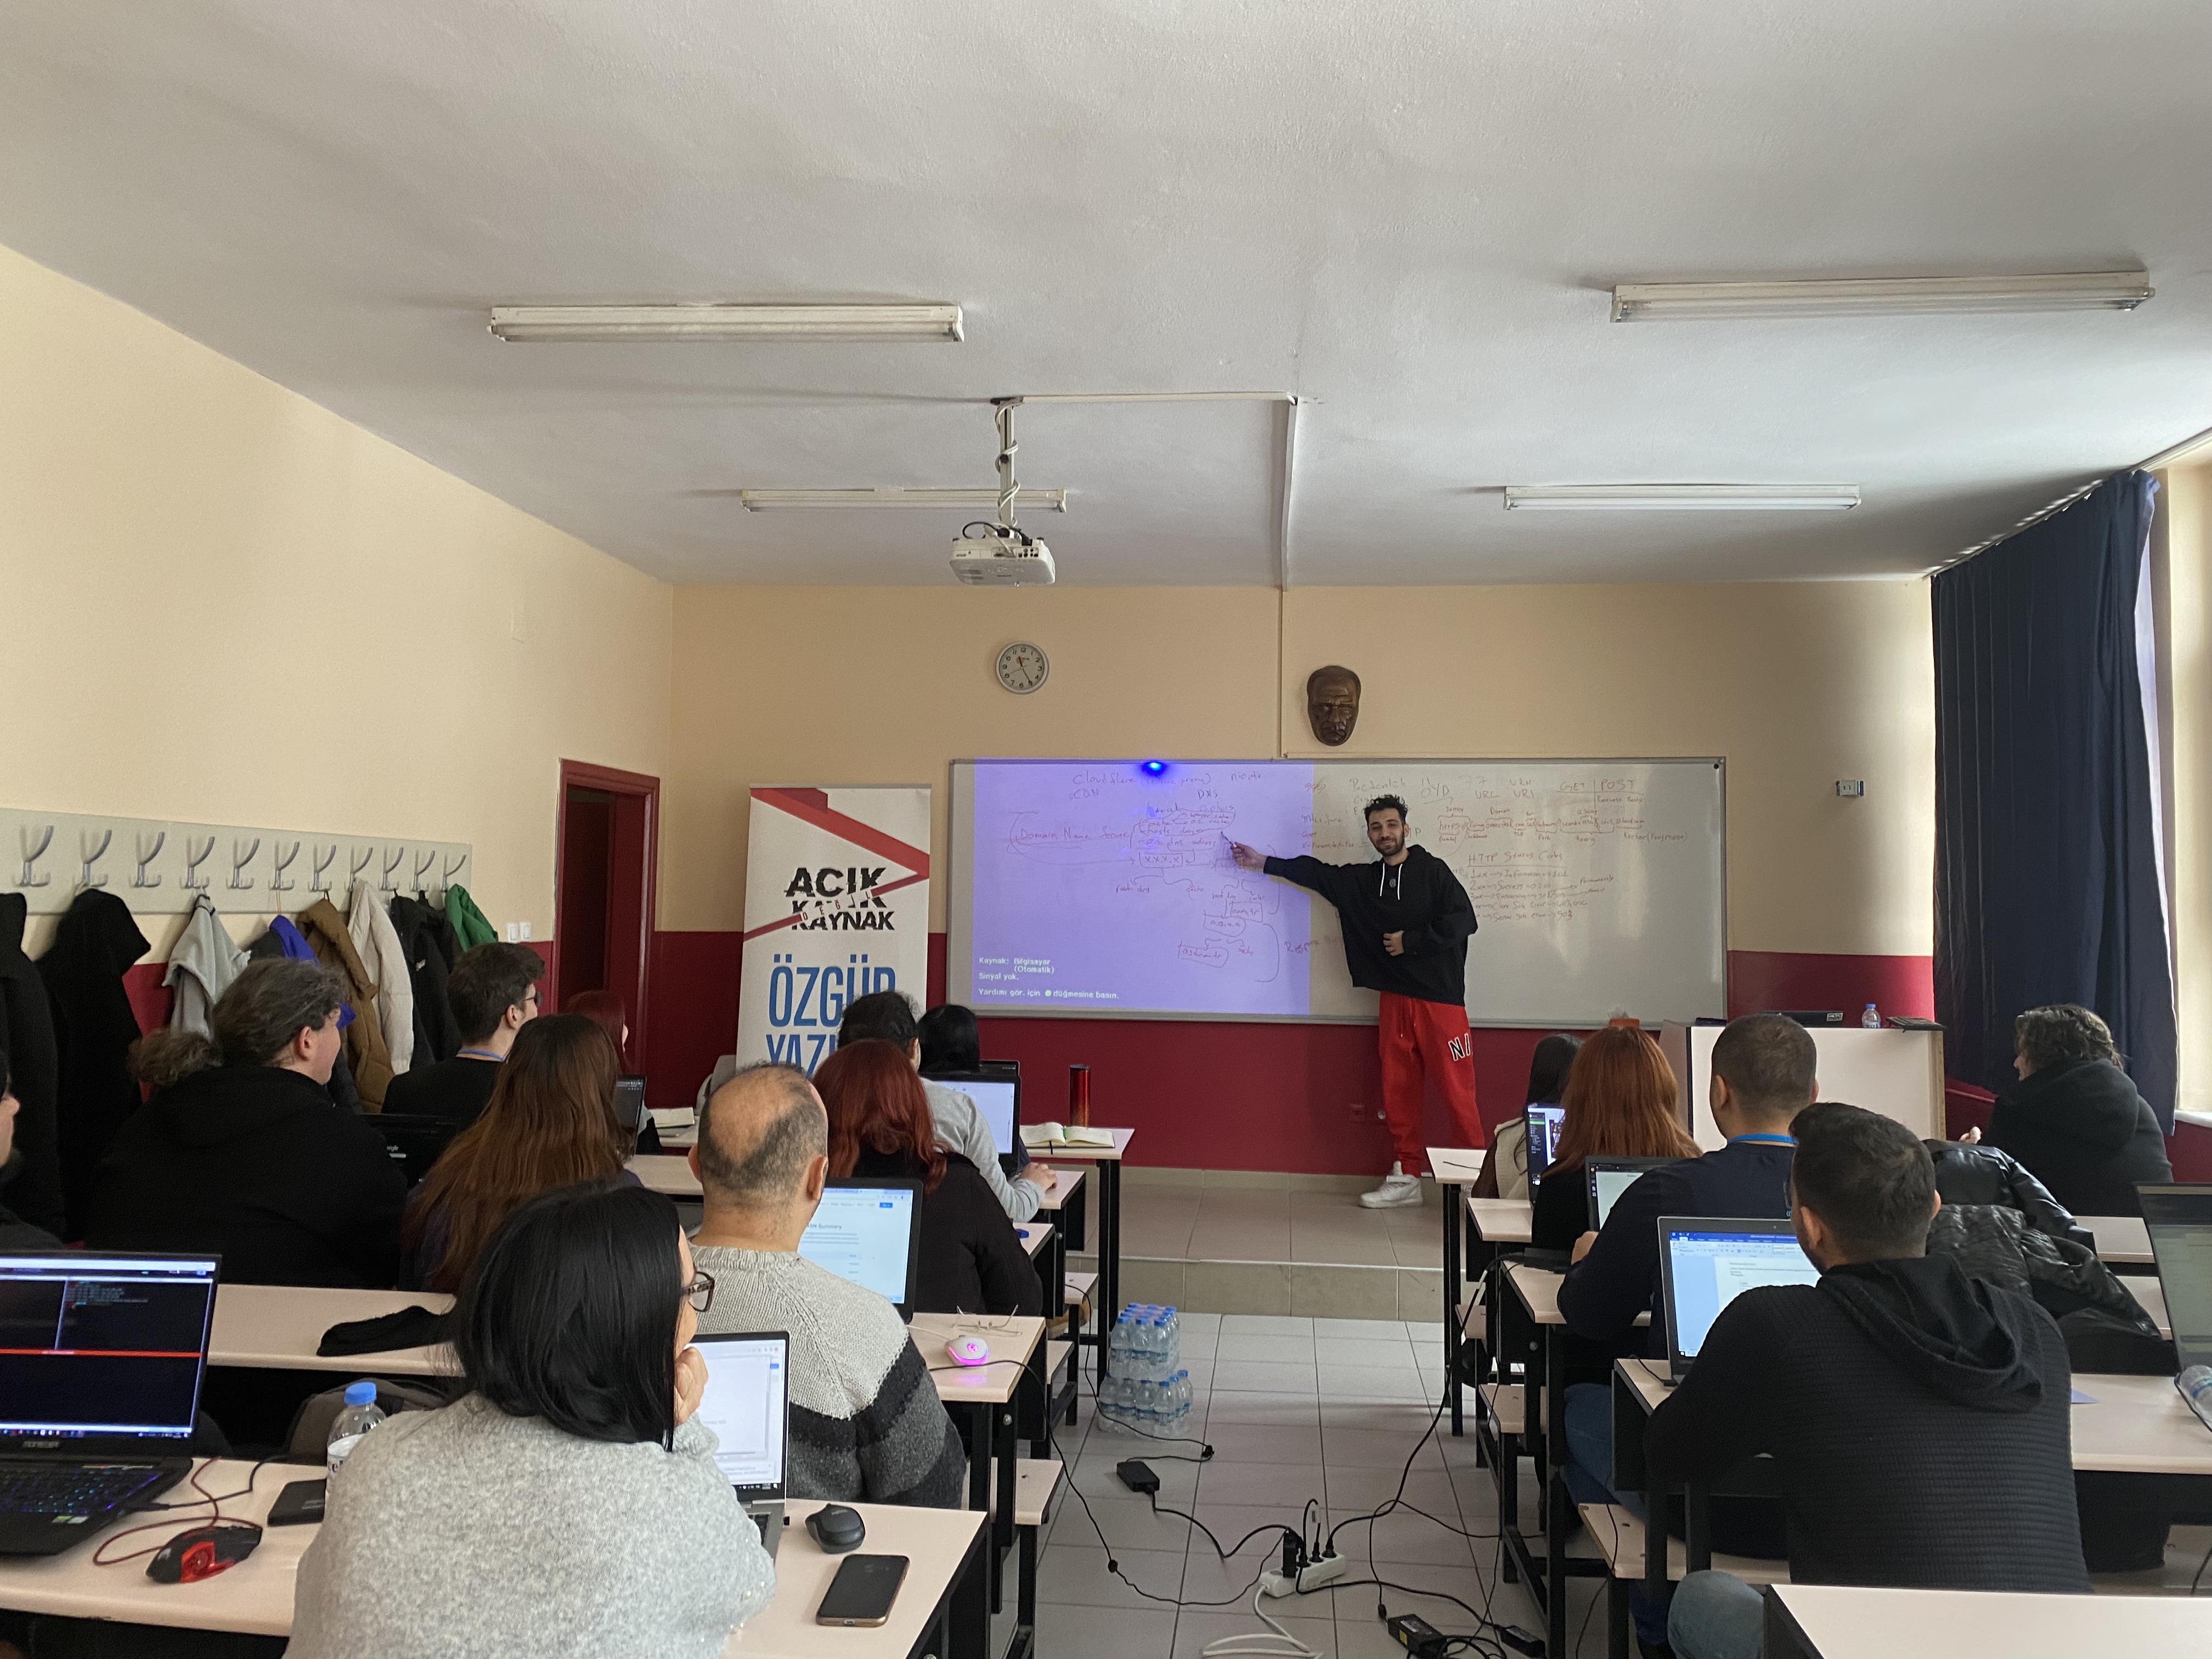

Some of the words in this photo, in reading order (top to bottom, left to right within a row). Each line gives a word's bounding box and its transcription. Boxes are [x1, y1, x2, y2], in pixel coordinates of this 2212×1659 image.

[1601, 778, 1634, 791] POST
[1475, 790, 1500, 799] URL
[1469, 853, 1498, 866] HTTP
[979, 957, 1009, 966] Kaynak:
[1014, 958, 1051, 966] Bilgisayar
[1014, 966, 1054, 975] (Otomatik)
[1009, 989, 1025, 997] gör.
[1027, 989, 1041, 997] için
[1053, 990, 1094, 998] düğmesine
[1096, 991, 1120, 1000] basın.
